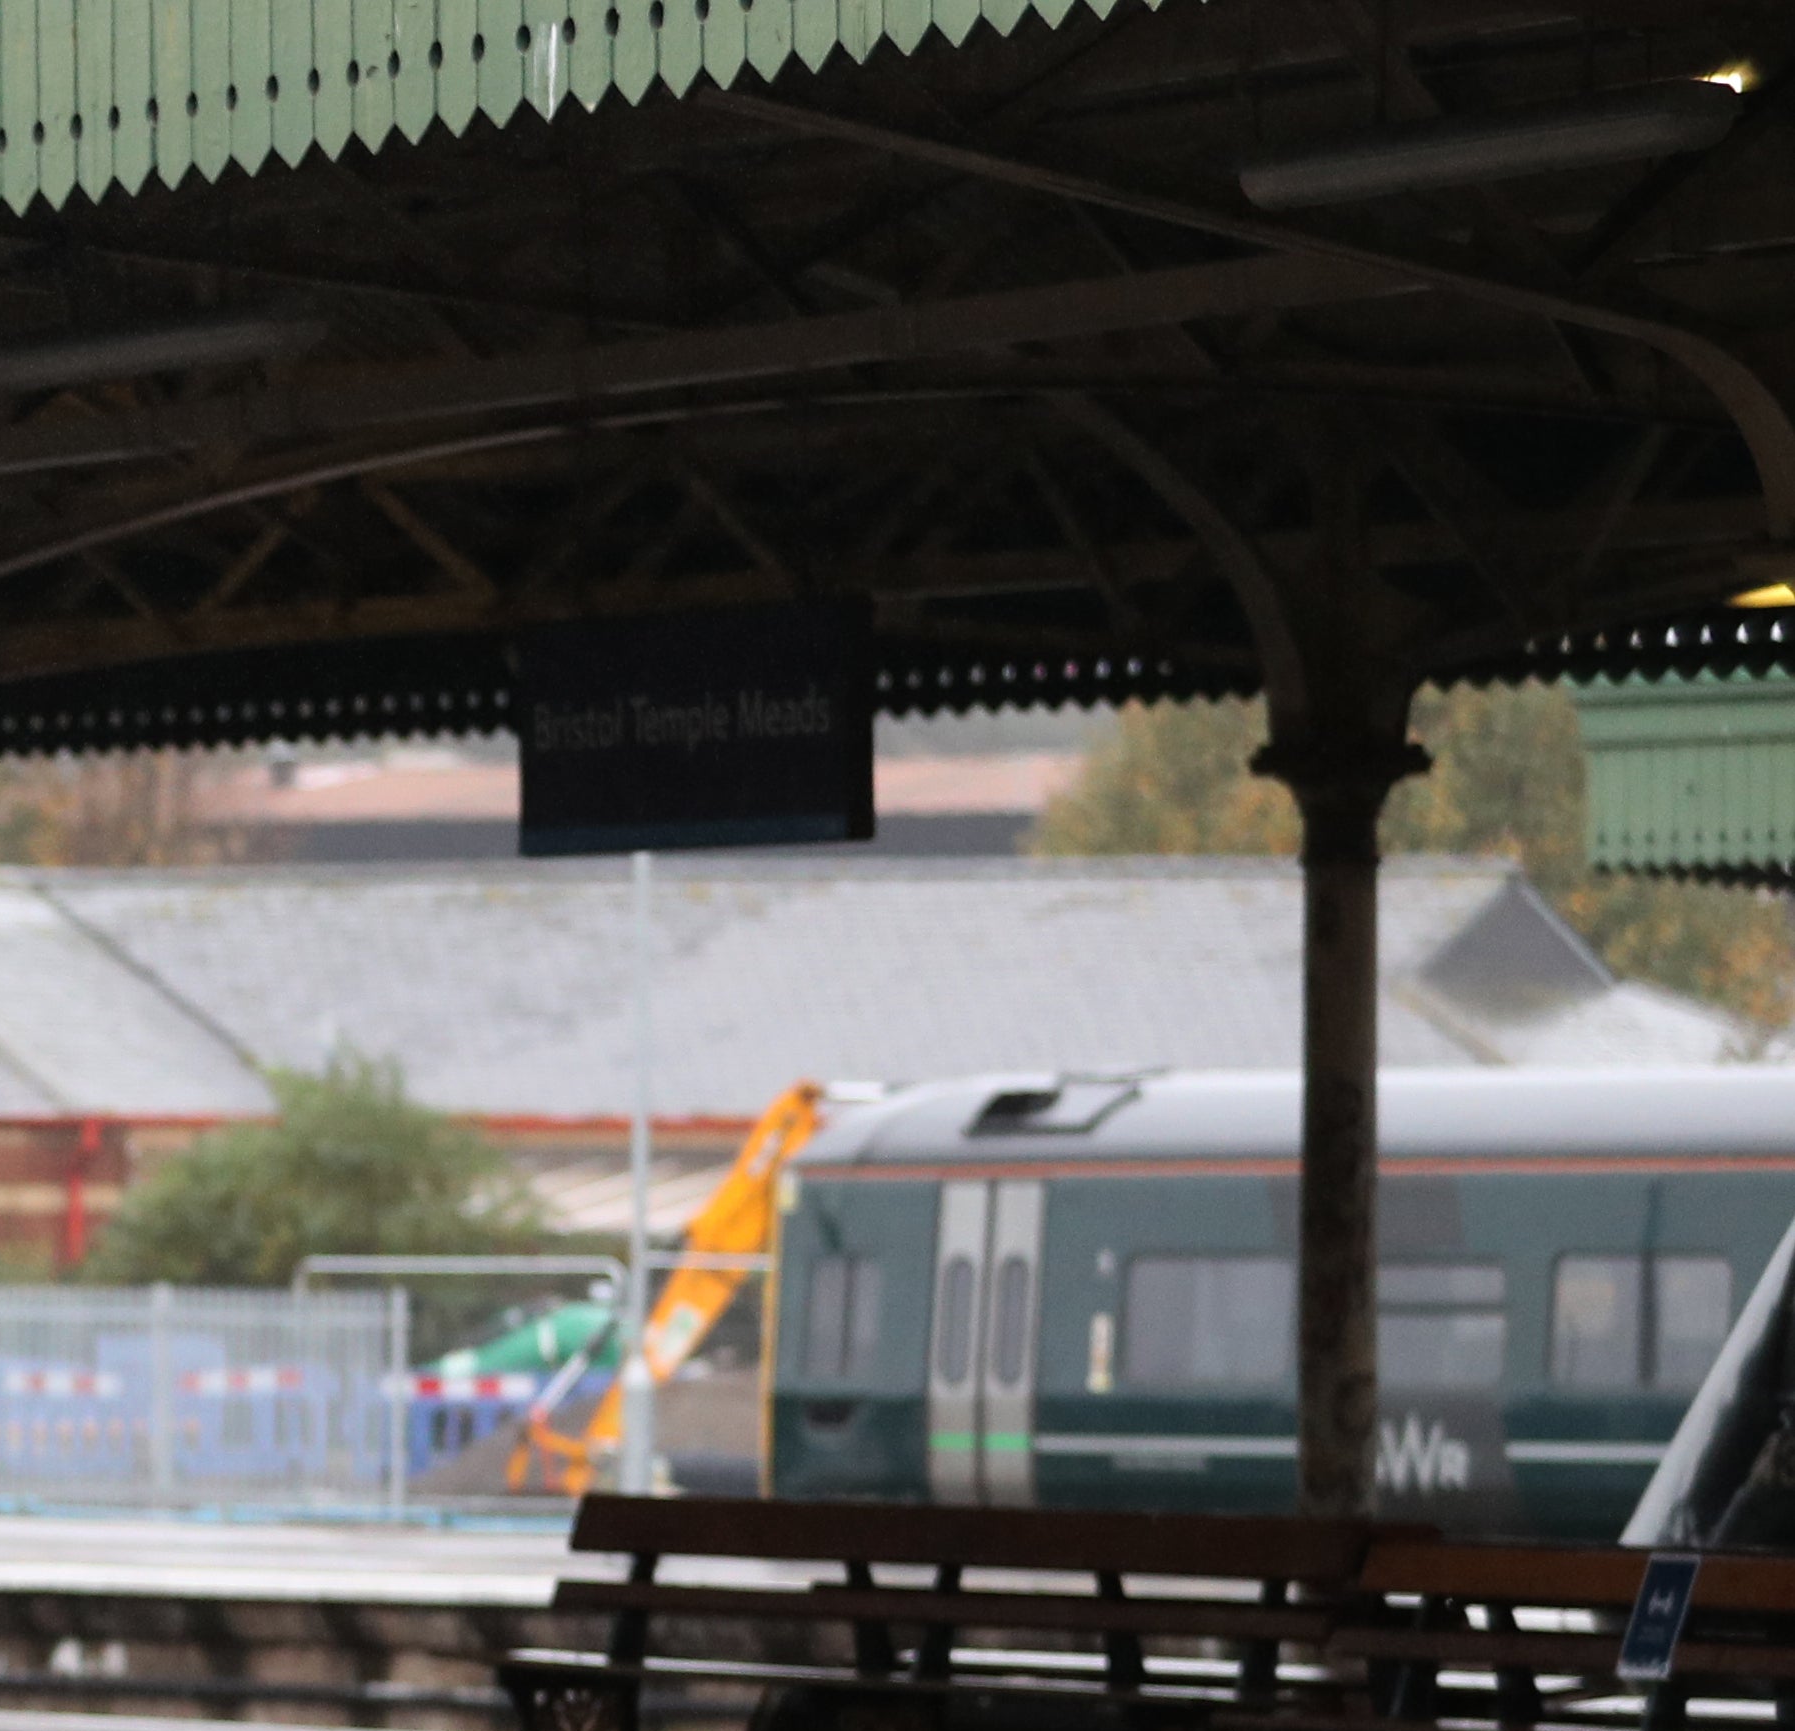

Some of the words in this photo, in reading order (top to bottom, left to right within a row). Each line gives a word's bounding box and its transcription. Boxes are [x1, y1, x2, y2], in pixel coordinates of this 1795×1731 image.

[534, 694, 624, 753] Bristol
[628, 691, 730, 752] Temple
[737, 684, 830, 739] Meads
[1375, 1405, 1468, 1491] WR
